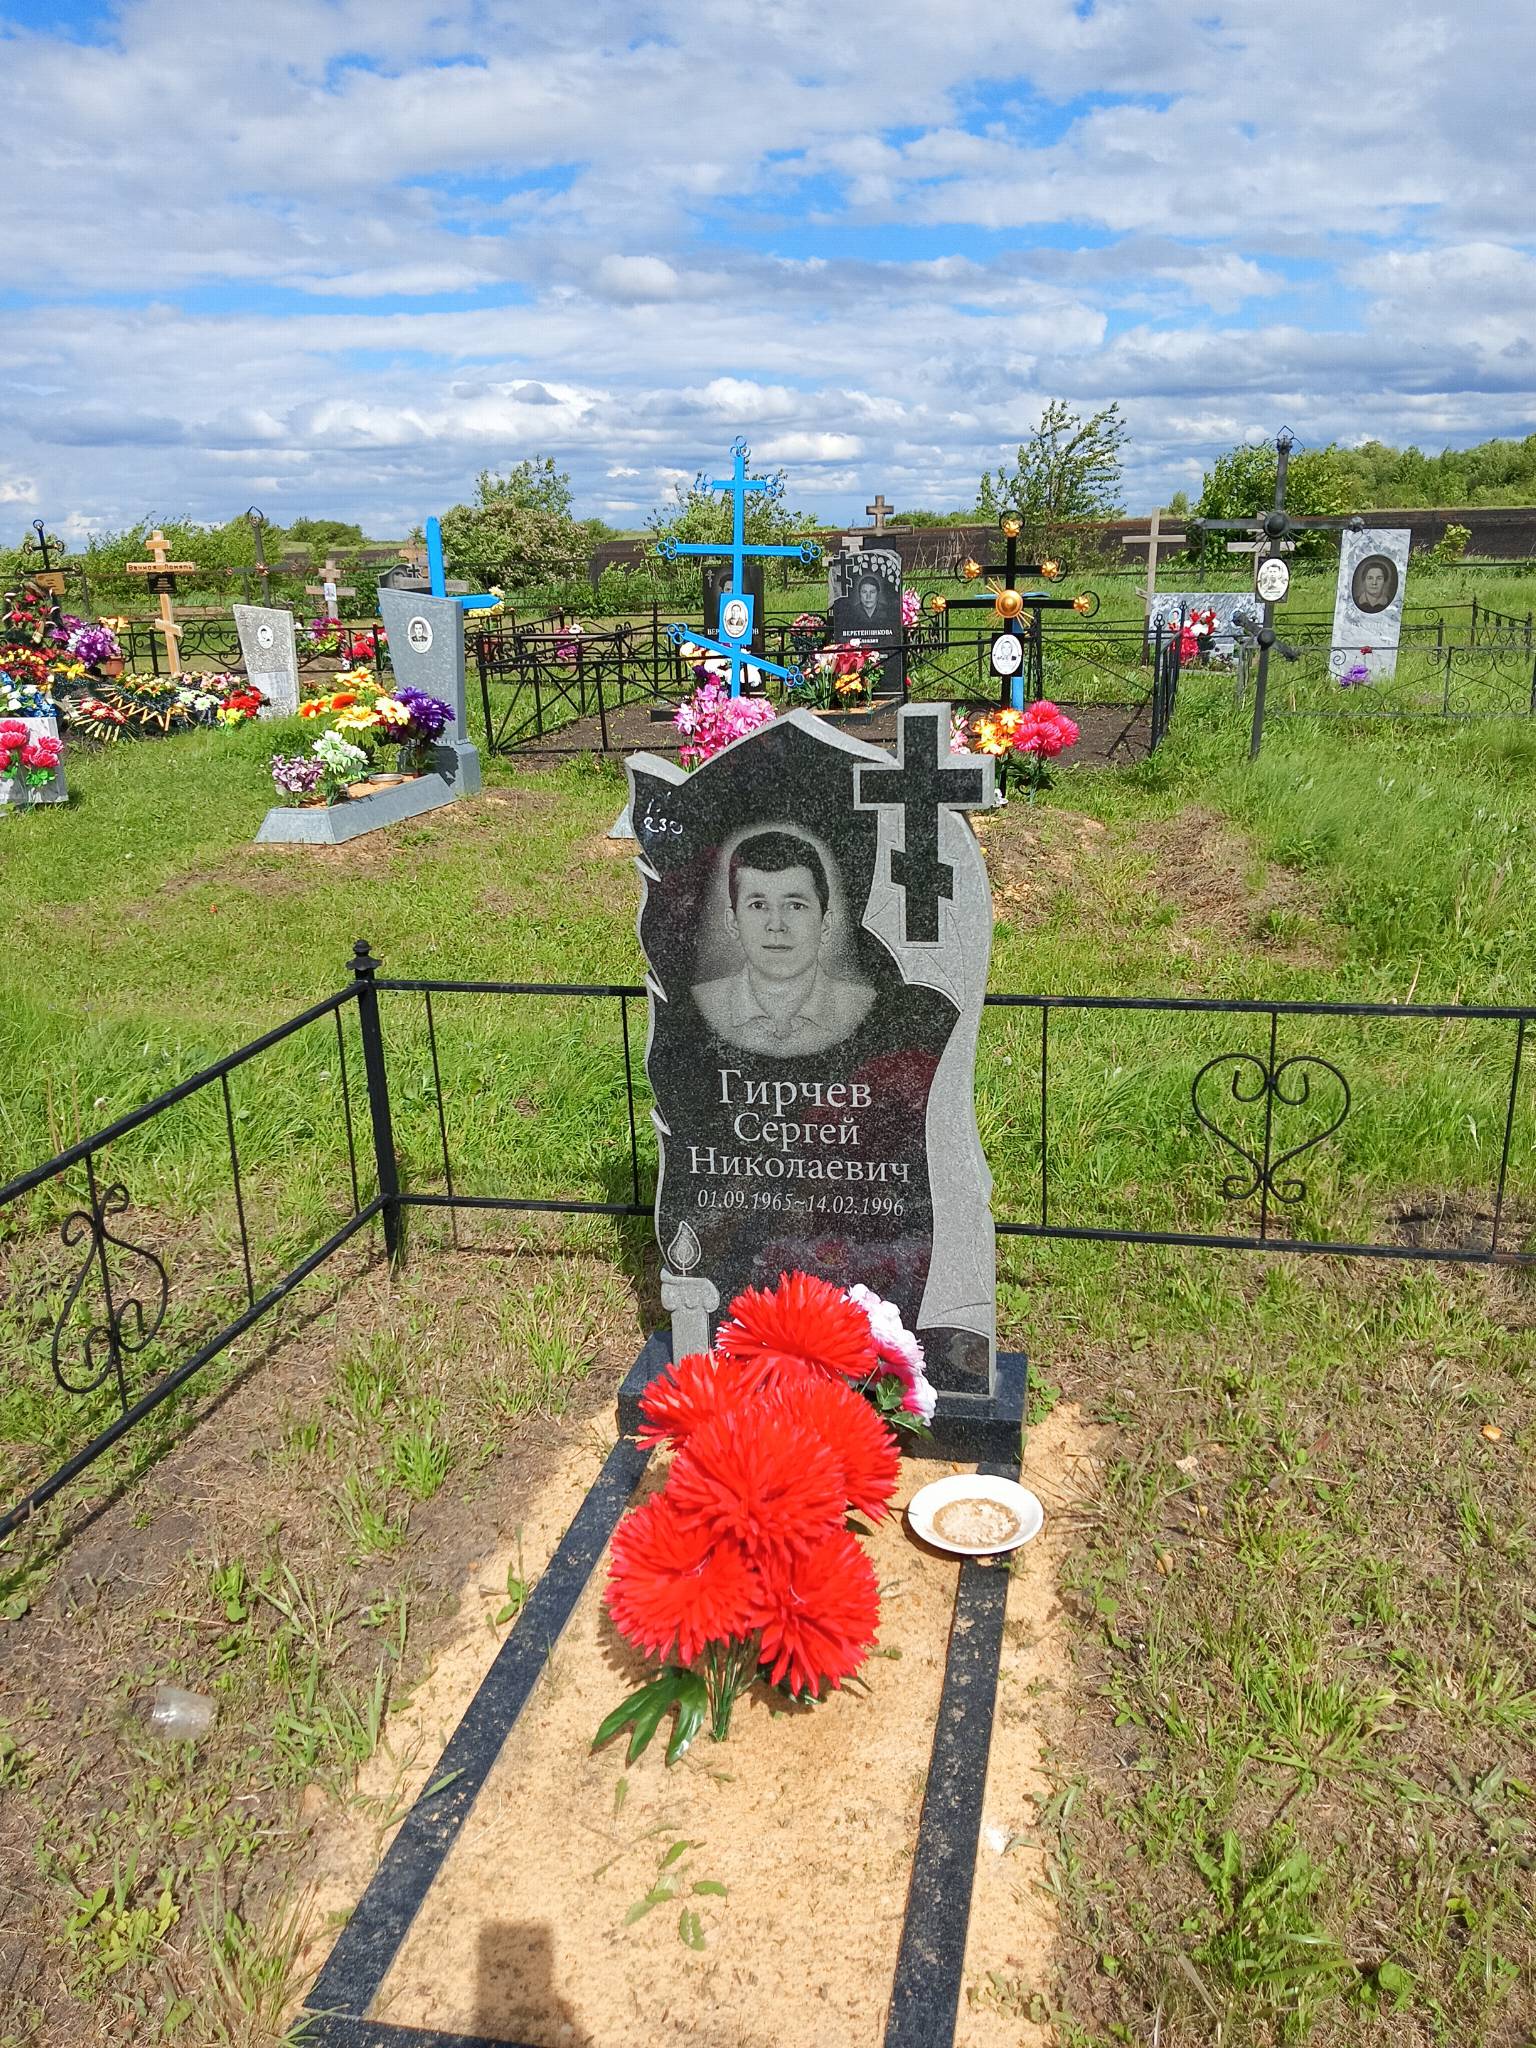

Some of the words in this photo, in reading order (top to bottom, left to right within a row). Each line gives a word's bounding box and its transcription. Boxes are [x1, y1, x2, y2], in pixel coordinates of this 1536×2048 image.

[718, 1068, 872, 1116] Гирчев
[733, 1111, 860, 1152] Сергей
[687, 1146, 910, 1183] Николаевич
